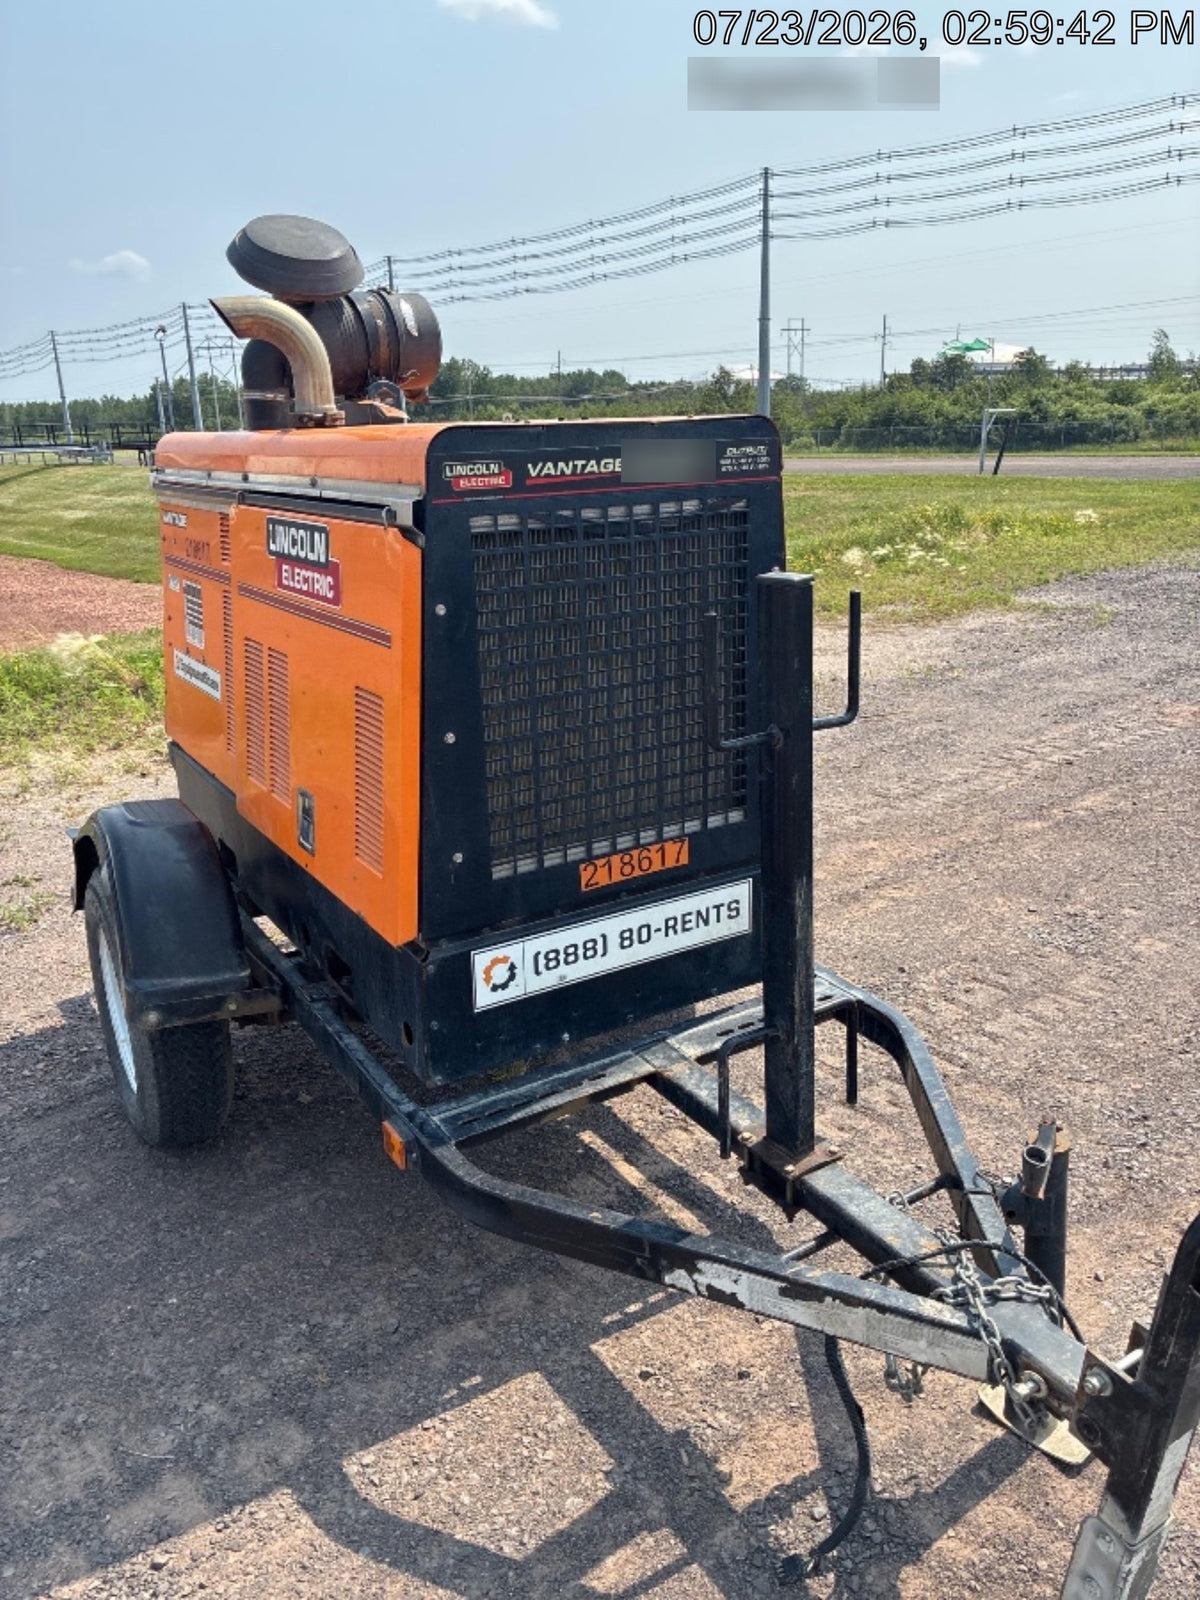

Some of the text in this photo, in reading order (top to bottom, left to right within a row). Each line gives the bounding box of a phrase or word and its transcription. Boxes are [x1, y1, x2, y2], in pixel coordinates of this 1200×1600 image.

[445, 463, 498, 476] LINCOLN
[459, 475, 505, 487] ELECTRIC
[269, 523, 327, 564] LINCOLN
[281, 563, 335, 599] ELECTRIC
[582, 837, 688, 888] 218617
[532, 898, 741, 976] (888) 80-RENTS
